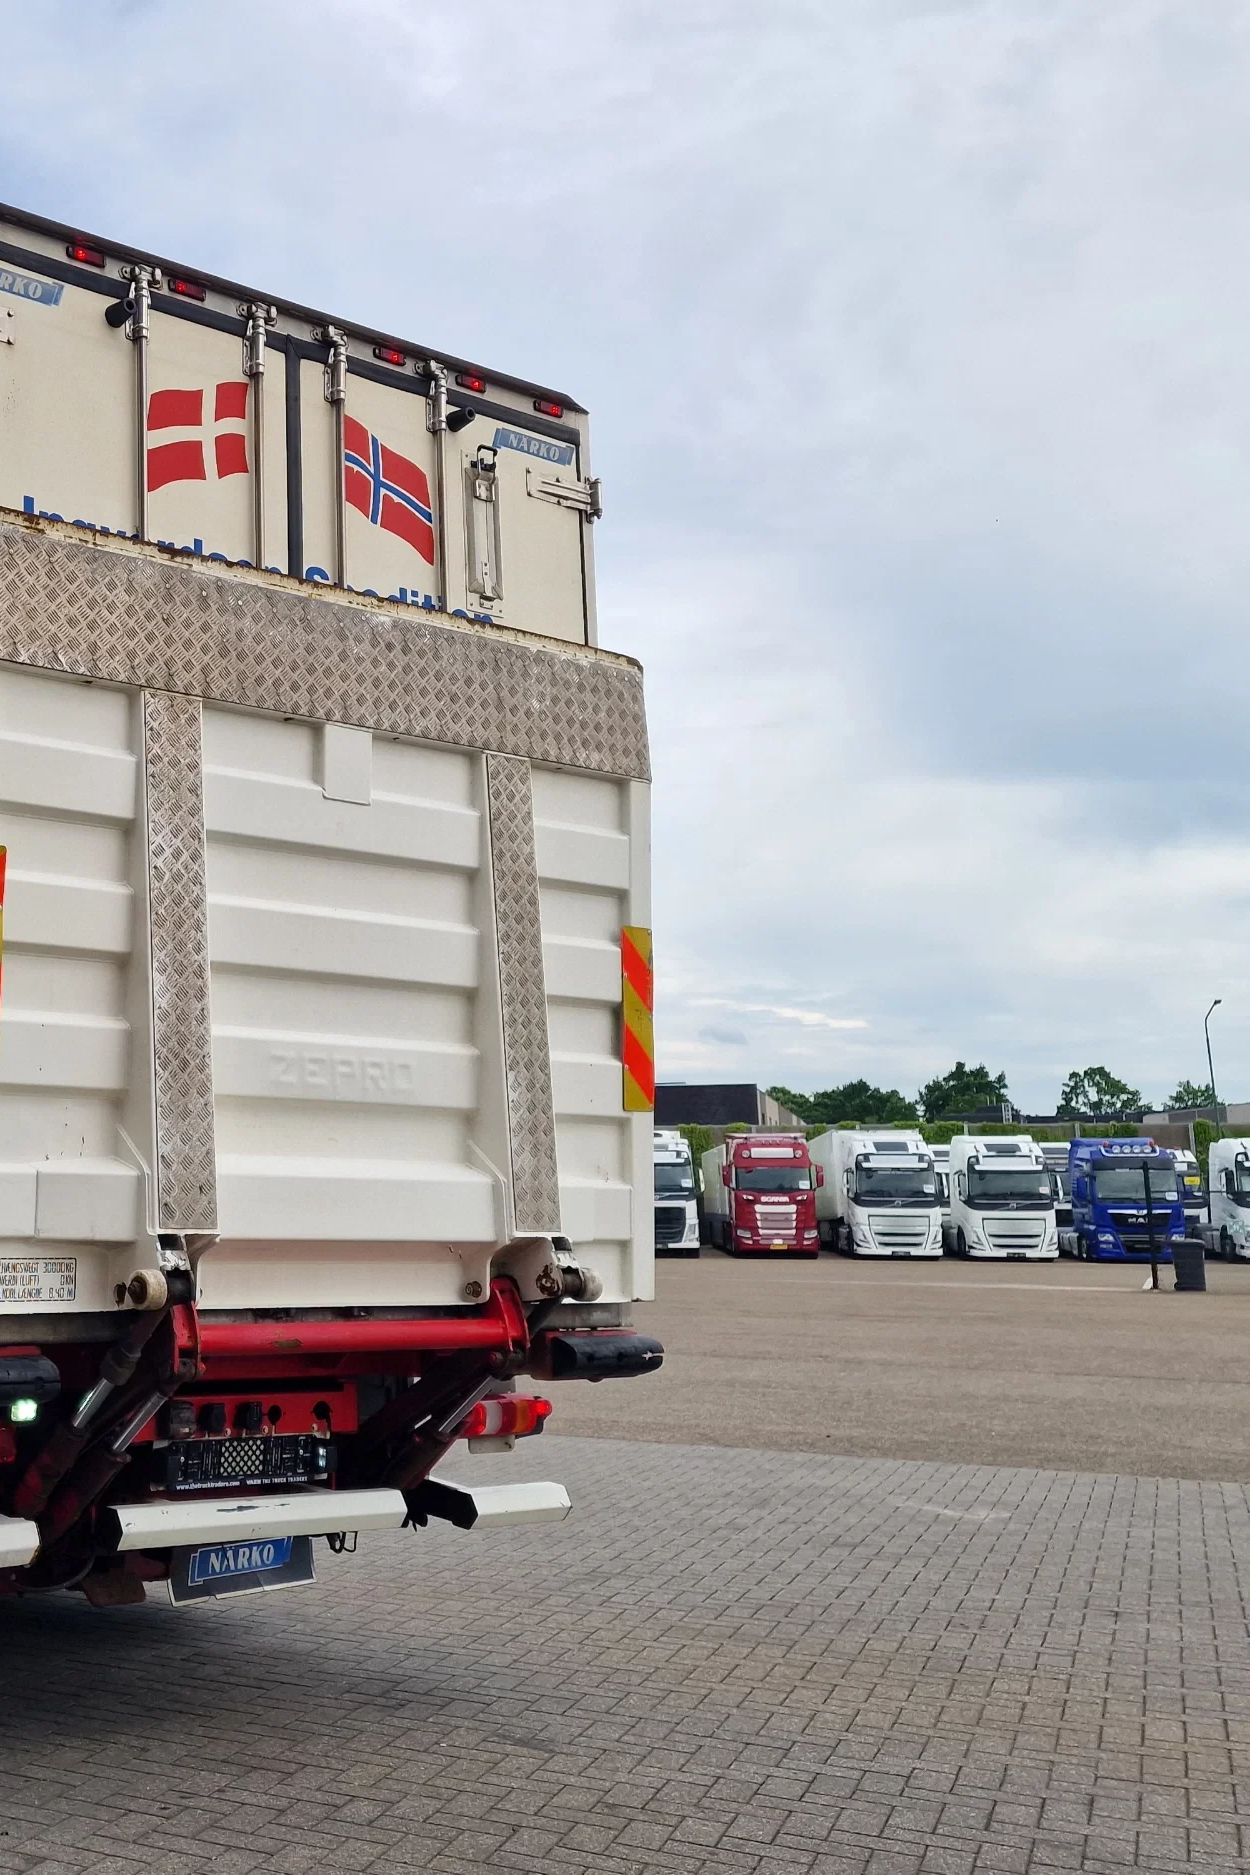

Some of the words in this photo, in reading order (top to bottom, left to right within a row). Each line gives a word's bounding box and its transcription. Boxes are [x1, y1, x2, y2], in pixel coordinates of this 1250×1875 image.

[508, 433, 560, 461] NÄRKO
[268, 1051, 416, 1097] ZEPRO
[760, 1195, 790, 1203] SCANIA
[209, 1543, 275, 1574] NÄRKO
